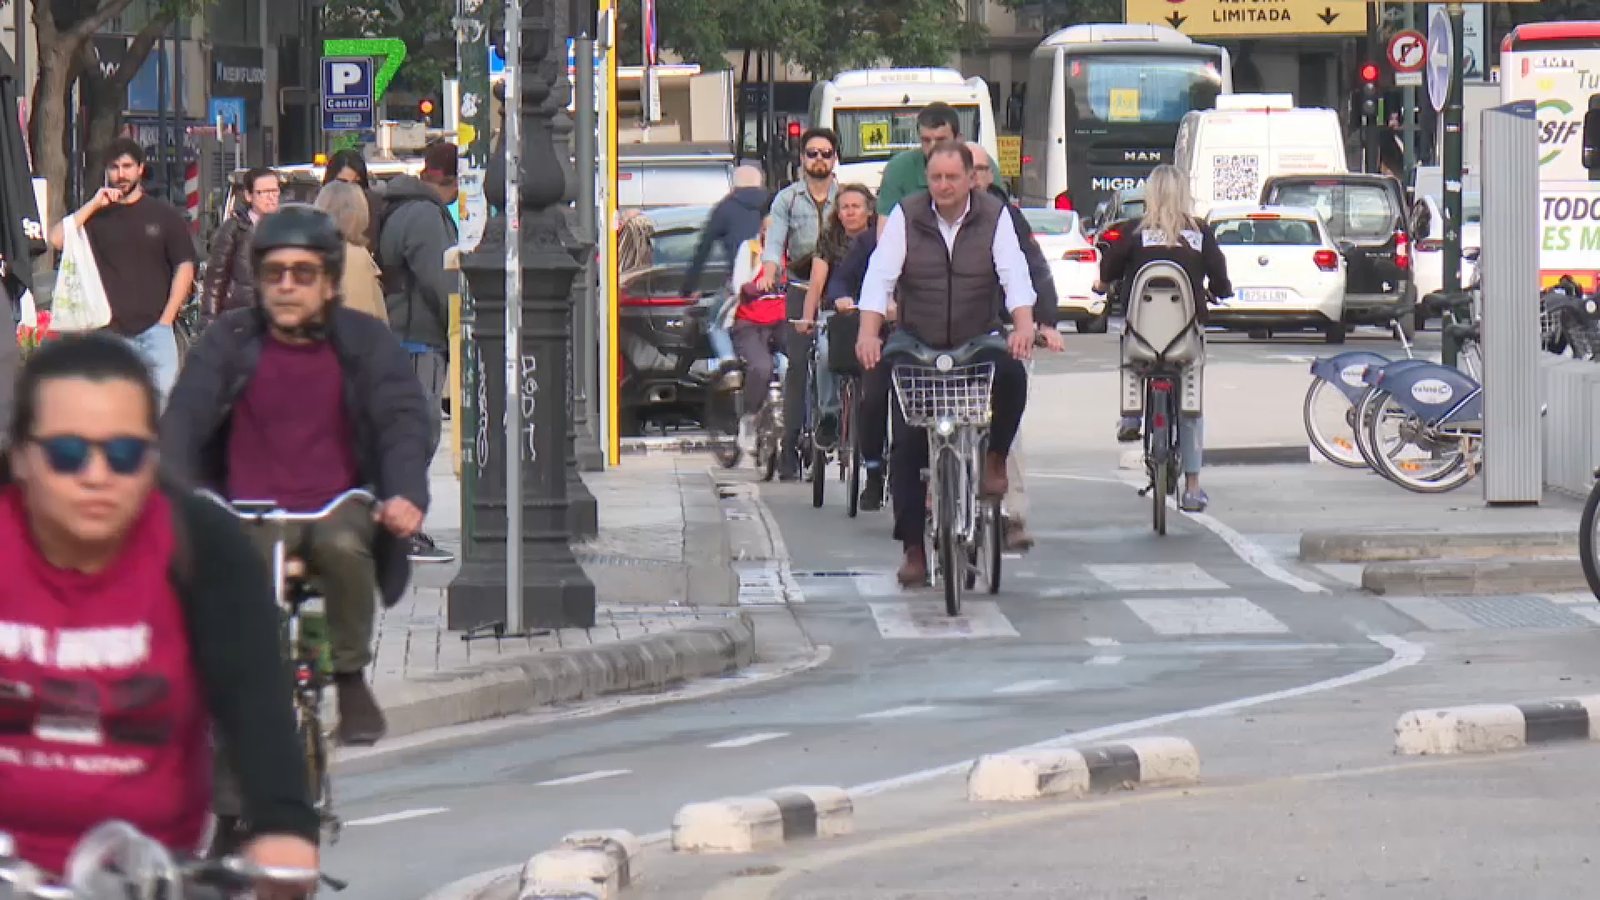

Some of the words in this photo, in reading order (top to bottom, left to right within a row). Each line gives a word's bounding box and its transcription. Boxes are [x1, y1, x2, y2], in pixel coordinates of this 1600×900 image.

[1213, 9, 1291, 22] LIMITADA
[331, 62, 362, 94] P
[327, 98, 367, 108] Central
[1538, 120, 1582, 144] SIF
[1124, 150, 1161, 161] MAN
[1543, 197, 1600, 221] TODO
[1542, 226, 1571, 250] ES
